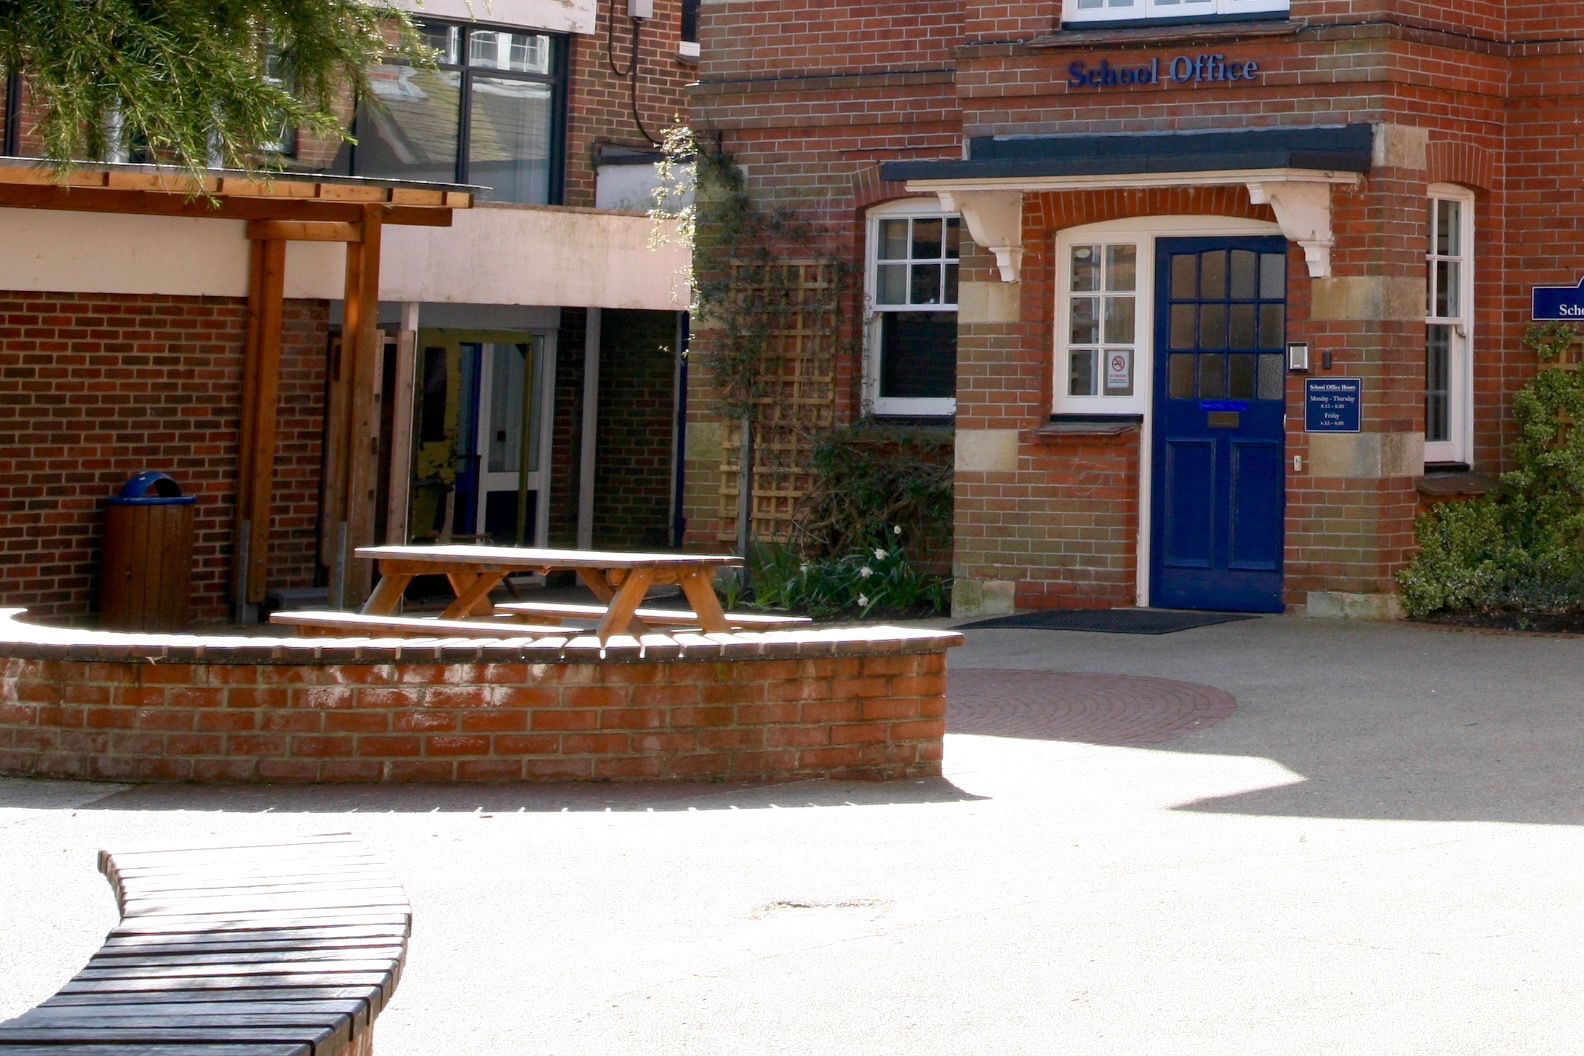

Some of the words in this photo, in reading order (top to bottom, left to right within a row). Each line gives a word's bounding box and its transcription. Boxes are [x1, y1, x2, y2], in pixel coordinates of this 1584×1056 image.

[1068, 57, 1159, 89] School
[1169, 53, 1258, 84] Office
[1310, 395, 1329, 403] Monday
[1333, 395, 1355, 403] Thursday
[1324, 412, 1340, 420] Friday
